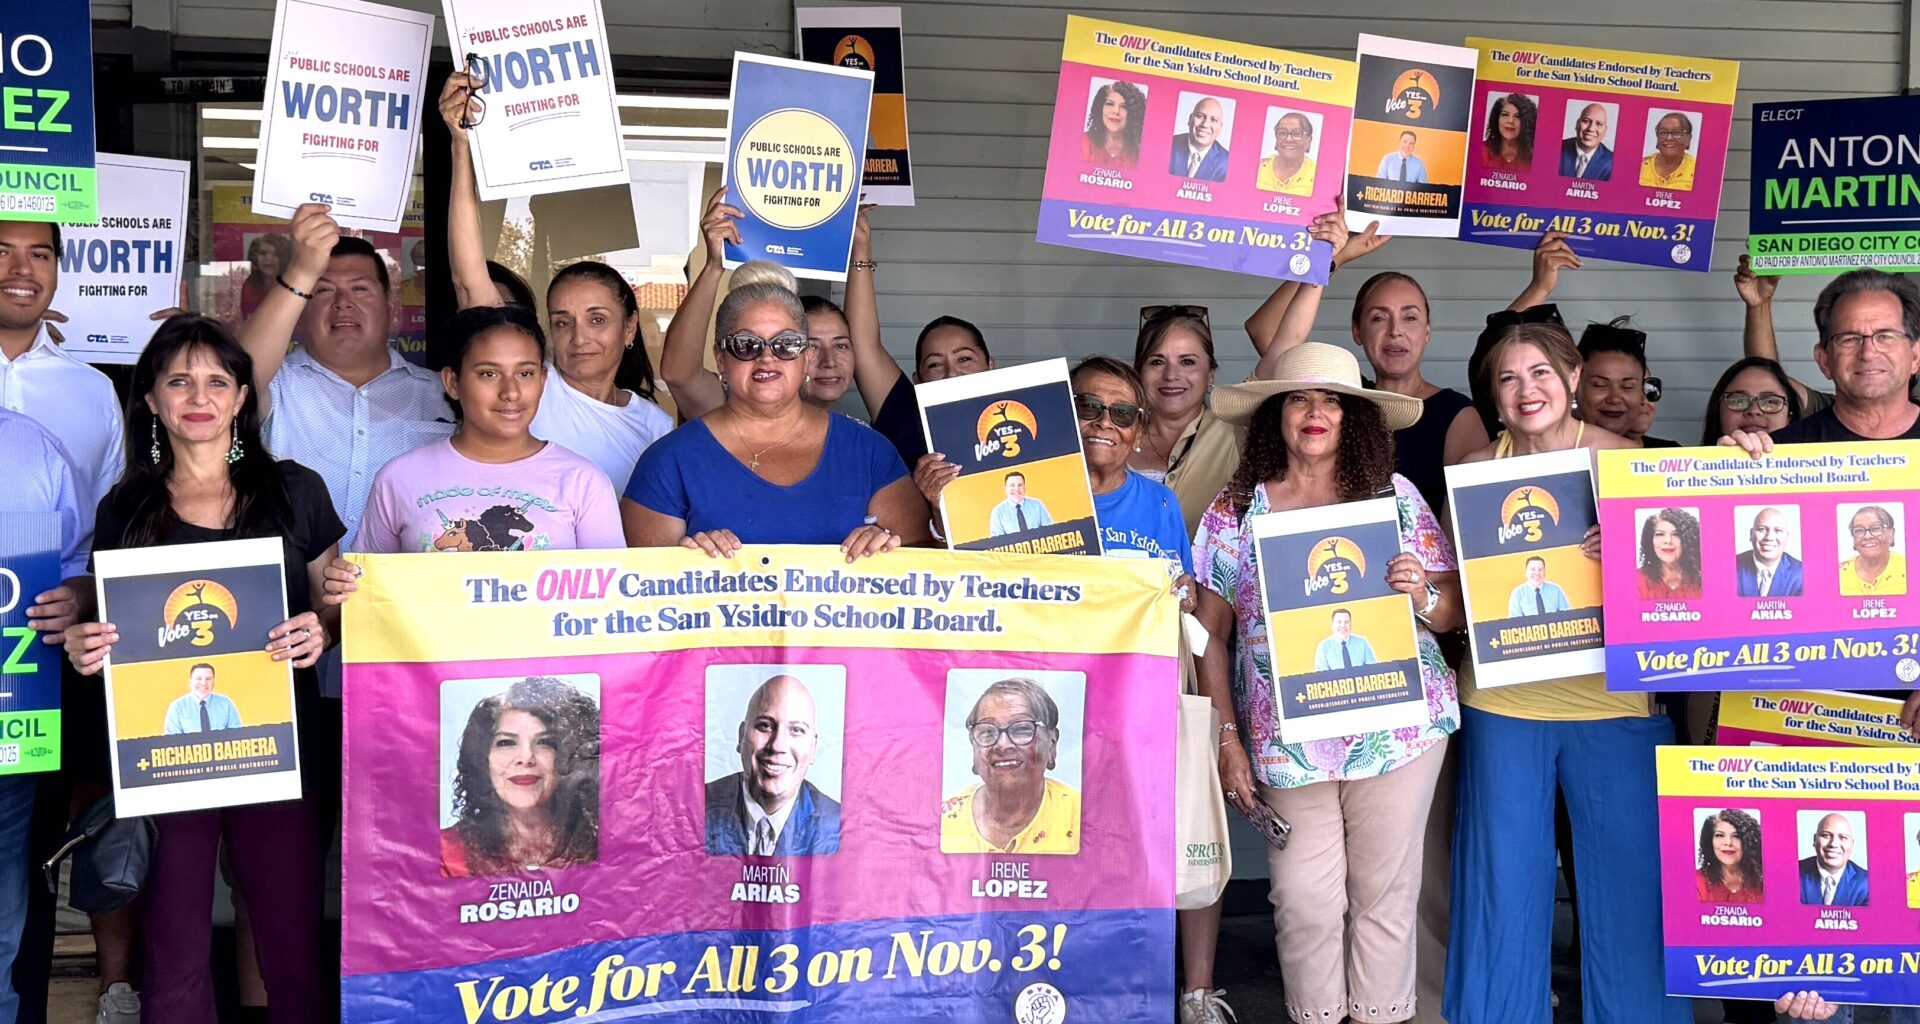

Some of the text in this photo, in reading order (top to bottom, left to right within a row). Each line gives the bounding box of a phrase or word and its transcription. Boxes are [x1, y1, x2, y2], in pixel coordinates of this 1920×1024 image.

[470, 15, 588, 45] PUBLIC SCHOOLS ARE
[290, 57, 410, 82] PUBLIC SCHOOLS ARE
[471, 39, 600, 94] WORTH
[1406, 91, 1420, 99] YES
[282, 80, 410, 130] WORTH
[505, 93, 580, 116] FIGHTING FOR
[1386, 97, 1422, 118] Vote 3
[1761, 109, 1804, 121] ELECT
[302, 133, 379, 152] FIGHTING FOR
[750, 141, 840, 157] PUBLIC SCHOOLS ARE
[1778, 134, 1920, 169] ANTON
[529, 160, 553, 170] CTA
[865, 159, 898, 172] ARRERA
[747, 158, 843, 192] WORTH
[1080, 174, 1132, 189] ROSARIO
[1480, 178, 1527, 190] ROSARIO
[310, 192, 333, 204] CTA
[764, 194, 820, 207] FIGHTING FOR
[1176, 190, 1212, 202] ARIAS
[1365, 186, 1448, 207] RICHARD BARRERA
[1566, 188, 1598, 199] ARIAS
[1765, 174, 1920, 209] MARTIN
[18, 196, 54, 211] #1460125
[1264, 203, 1300, 216] LOPEZ
[1646, 198, 1681, 209] LOPEZ
[102, 217, 149, 229] SCHOOLS
[152, 219, 171, 229] ARE
[1068, 209, 1312, 251] Vote for All 3 on Nov. 3!
[1471, 210, 1695, 241] Vote for All 3 on Nov. 3!
[766, 245, 785, 254] CTA
[1758, 239, 1792, 252] SAN
[1800, 237, 1854, 251] DIEGO
[1860, 236, 1900, 249] CITY
[59, 239, 172, 273] WORTH
[1779, 256, 1790, 266] FOR
[1800, 256, 1828, 266] ANTONIO
[1829, 255, 1860, 266] MARTINEZ
[1861, 255, 1872, 265] FOR
[1874, 255, 1886, 265] CITY
[1888, 254, 1916, 265] COUNCIL
[79, 286, 148, 296] FIGHTING FOR
[87, 334, 108, 343] CTA
[994, 426, 1013, 436] YES
[975, 434, 1020, 461] Vote 3
[1631, 454, 1905, 472] The ONLY Candidates Endorsed by Teachers
[1666, 471, 1869, 488] for the San Ysidro School Board.
[1518, 511, 1536, 521] YES
[1106, 527, 1126, 543] San
[1498, 520, 1542, 544] Vote 3
[1032, 530, 1084, 554] BARRERA
[1324, 562, 1342, 572] YES
[466, 568, 1081, 603] The ONLY Candidates Endorsed by Teachers
[1304, 571, 1348, 596] Vote 3
[184, 610, 208, 620] YES
[553, 603, 1002, 636] for the San Ysidro School Board.
[1642, 611, 1701, 622] ROSARIO
[1751, 610, 1792, 620] ARIAS
[1852, 608, 1897, 619] LOPEZ
[158, 620, 214, 647] Vote 3
[1500, 617, 1600, 646] RICHARD BARRERA
[1635, 633, 1918, 673] Vote for All 3 on Nov. 3!
[1306, 678, 1355, 700] RICHARD
[1355, 671, 1407, 693] BARRERA
[151, 737, 277, 768] RICHARD BARRERA
[743, 864, 790, 883] MARTÍN
[990, 862, 1029, 878] IRENE
[489, 879, 554, 900] ZENAIDA
[731, 883, 800, 903] ARIAS
[971, 879, 1048, 899] LOPEZ
[460, 893, 580, 924] ROSARIO
[1701, 915, 1762, 927] ROSARIO
[1815, 919, 1858, 930] ARIAS
[454, 924, 1068, 1024] Vote for All 3 on Nov. 3!
[1695, 955, 1749, 975] Vote
[1748, 954, 1792, 981] for
[1796, 953, 1834, 975] All
[1838, 953, 1855, 975] 3
[1860, 958, 1894, 974] on
